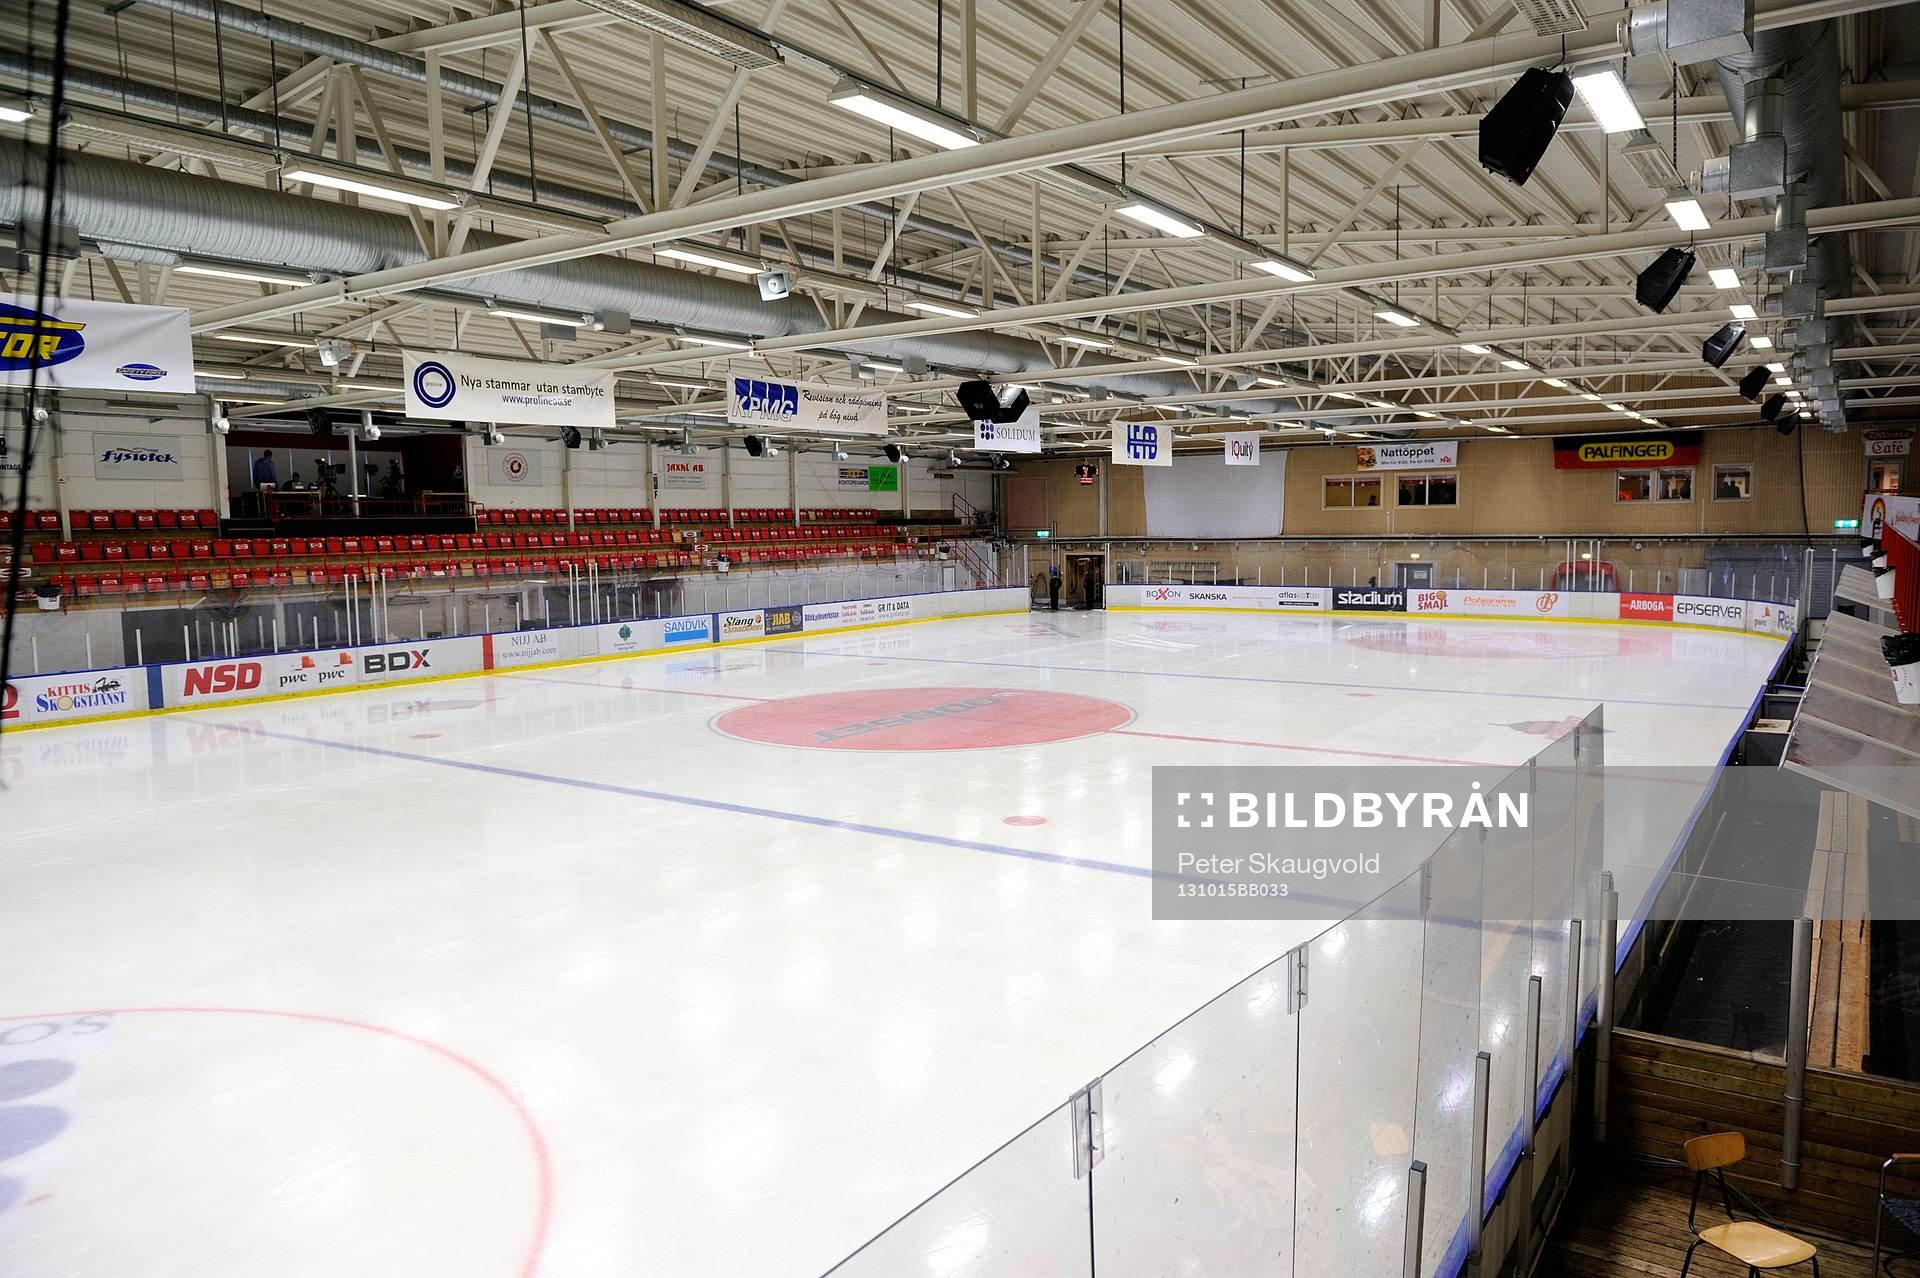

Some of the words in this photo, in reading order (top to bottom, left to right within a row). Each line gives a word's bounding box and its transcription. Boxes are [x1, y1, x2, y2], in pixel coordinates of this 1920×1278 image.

[461, 374, 482, 391] Nya
[485, 377, 531, 391] stammar
[536, 382, 559, 393] utan
[561, 384, 604, 398] stambyte
[802, 389, 834, 403] Revision
[835, 393, 847, 405] och
[848, 396, 883, 409] rådgivning
[732, 394, 795, 422] KPMG
[817, 409, 829, 421] på
[829, 408, 841, 422] hög
[842, 413, 859, 422] nivå
[996, 426, 1036, 441] SOLIDUM
[1231, 440, 1254, 460] IQuity
[1380, 447, 1435, 459] Nattöppet
[1583, 443, 1668, 459] PALFINGER
[1871, 441, 1904, 454] Café
[692, 464, 704, 472] AB
[1146, 587, 1181, 601] BOXON
[1189, 592, 1228, 600] SKANSKA
[1338, 591, 1403, 608] stadium
[1418, 593, 1436, 602] BIG
[877, 603, 886, 613] GR
[886, 603, 891, 611] IT
[896, 601, 910, 610] DATA
[1630, 599, 1665, 612] ARBOGA
[664, 619, 708, 633] SANDVIK
[724, 616, 754, 627] Slang
[772, 612, 791, 626] JIAB
[1754, 618, 1767, 627] pwc
[511, 635, 531, 647] NIJJ
[533, 633, 547, 644] AB
[502, 645, 557, 659] www.nijjab.com
[364, 649, 432, 674] BDX
[183, 662, 262, 697] NSD
[279, 671, 308, 687] pwc
[318, 668, 345, 684] pwc
[47, 683, 91, 697] KITTIS
